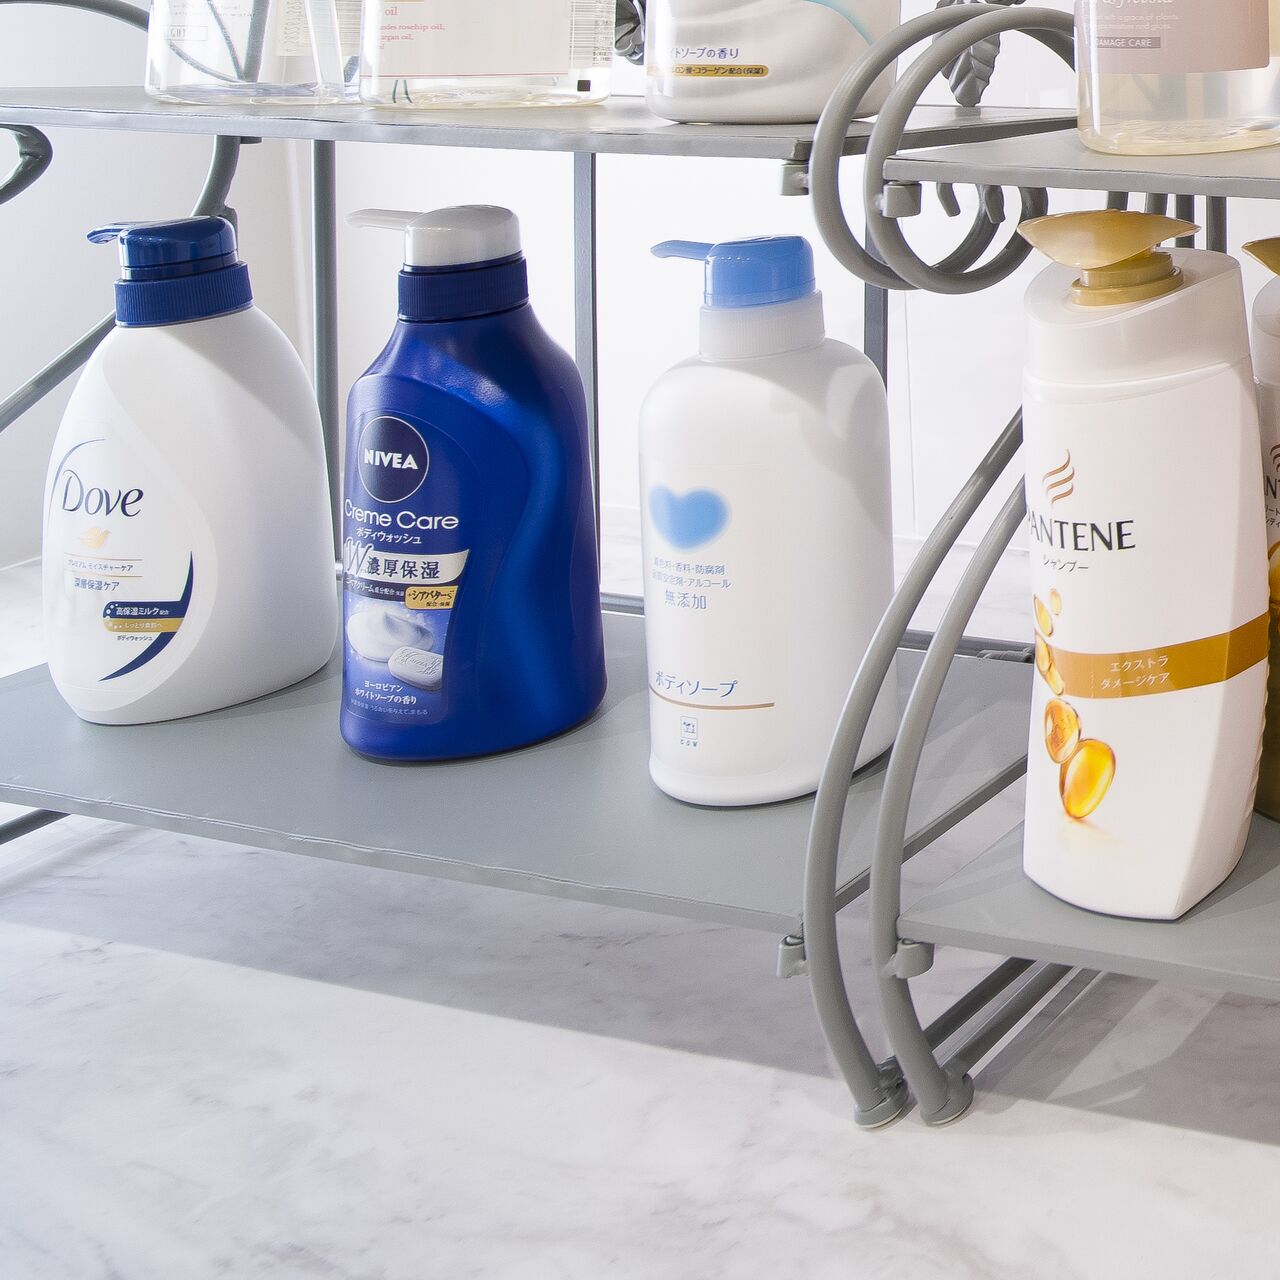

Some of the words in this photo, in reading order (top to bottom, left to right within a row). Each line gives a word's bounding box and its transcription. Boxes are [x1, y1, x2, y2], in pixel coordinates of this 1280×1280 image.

[1096, 38, 1127, 47] AMAGE
[1128, 38, 1153, 48] CARE
[363, 448, 419, 470] NIVEA
[62, 469, 144, 517] Dove
[345, 498, 392, 527] Creme
[396, 510, 460, 530] Care
[356, 527, 422, 545] ボディウォッシュ
[1043, 555, 1089, 573] シャンプー
[665, 589, 707, 610] 無添加
[1109, 654, 1169, 673] エクストラ
[654, 670, 739, 698] ボディソープ
[1100, 672, 1171, 690] ダメージケア
